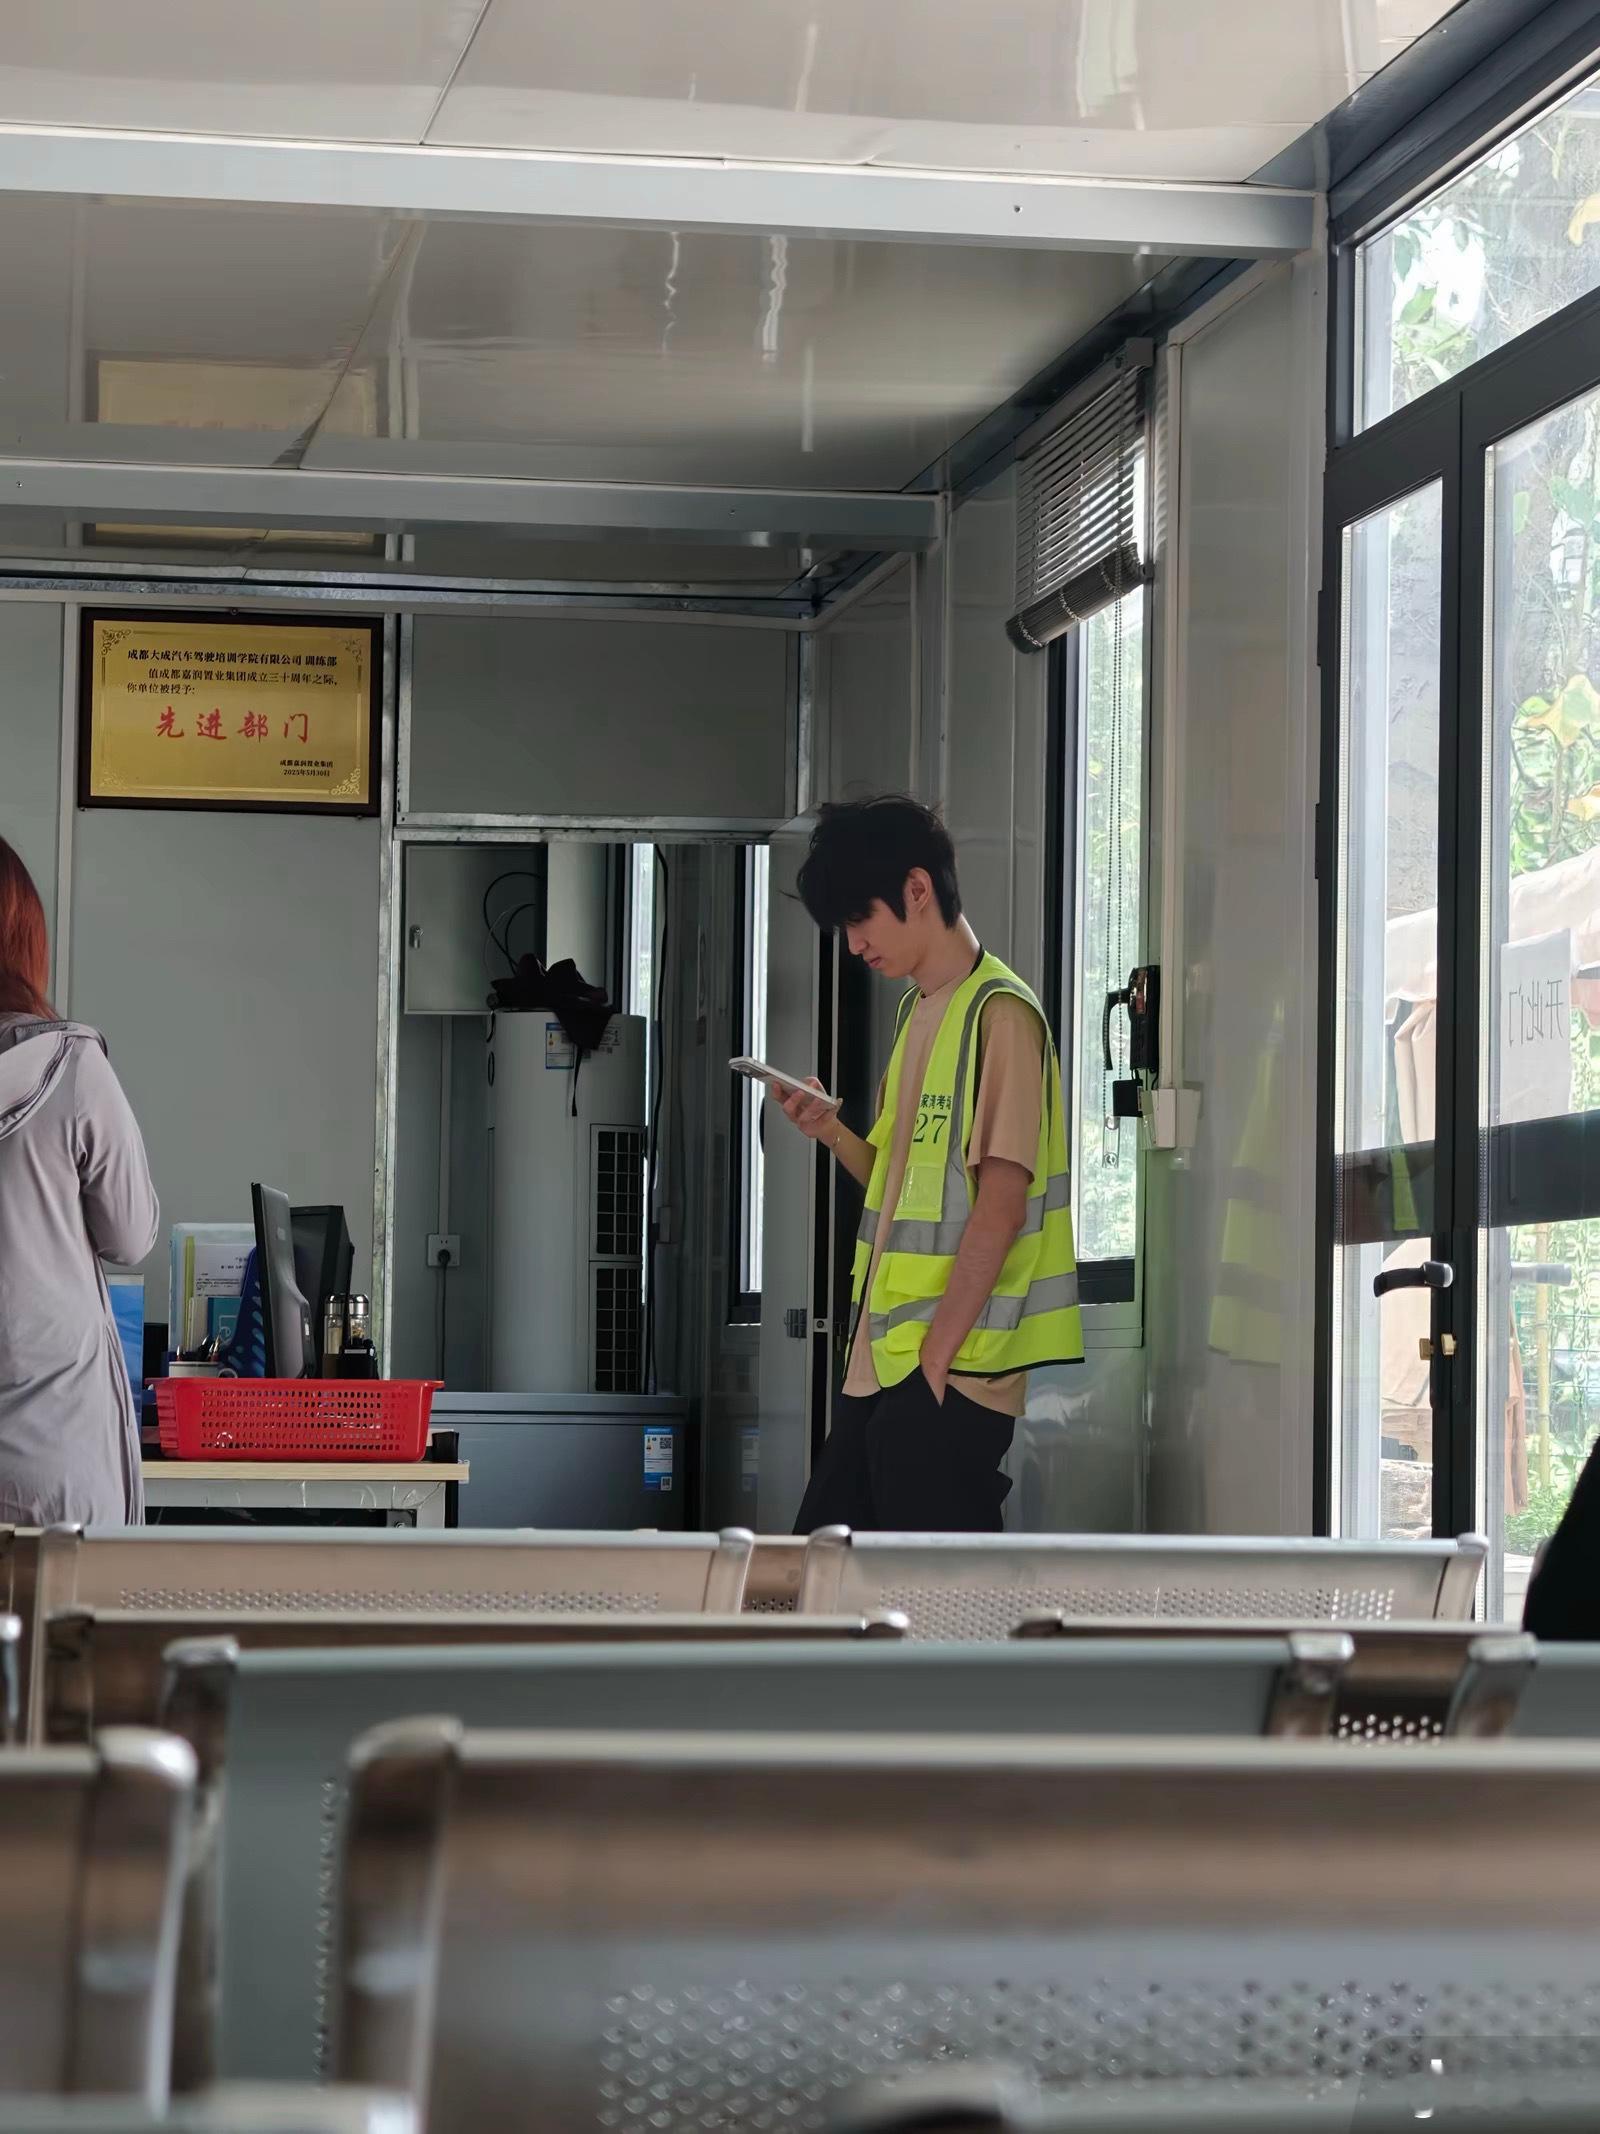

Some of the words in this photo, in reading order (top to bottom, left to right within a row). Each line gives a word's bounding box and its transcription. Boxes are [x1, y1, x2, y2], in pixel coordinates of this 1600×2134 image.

[127, 649, 302, 666] 成都大成汽车驾驶培训学院有限公司
[155, 705, 309, 743] 先进部门
[913, 1113, 948, 1144] 27
